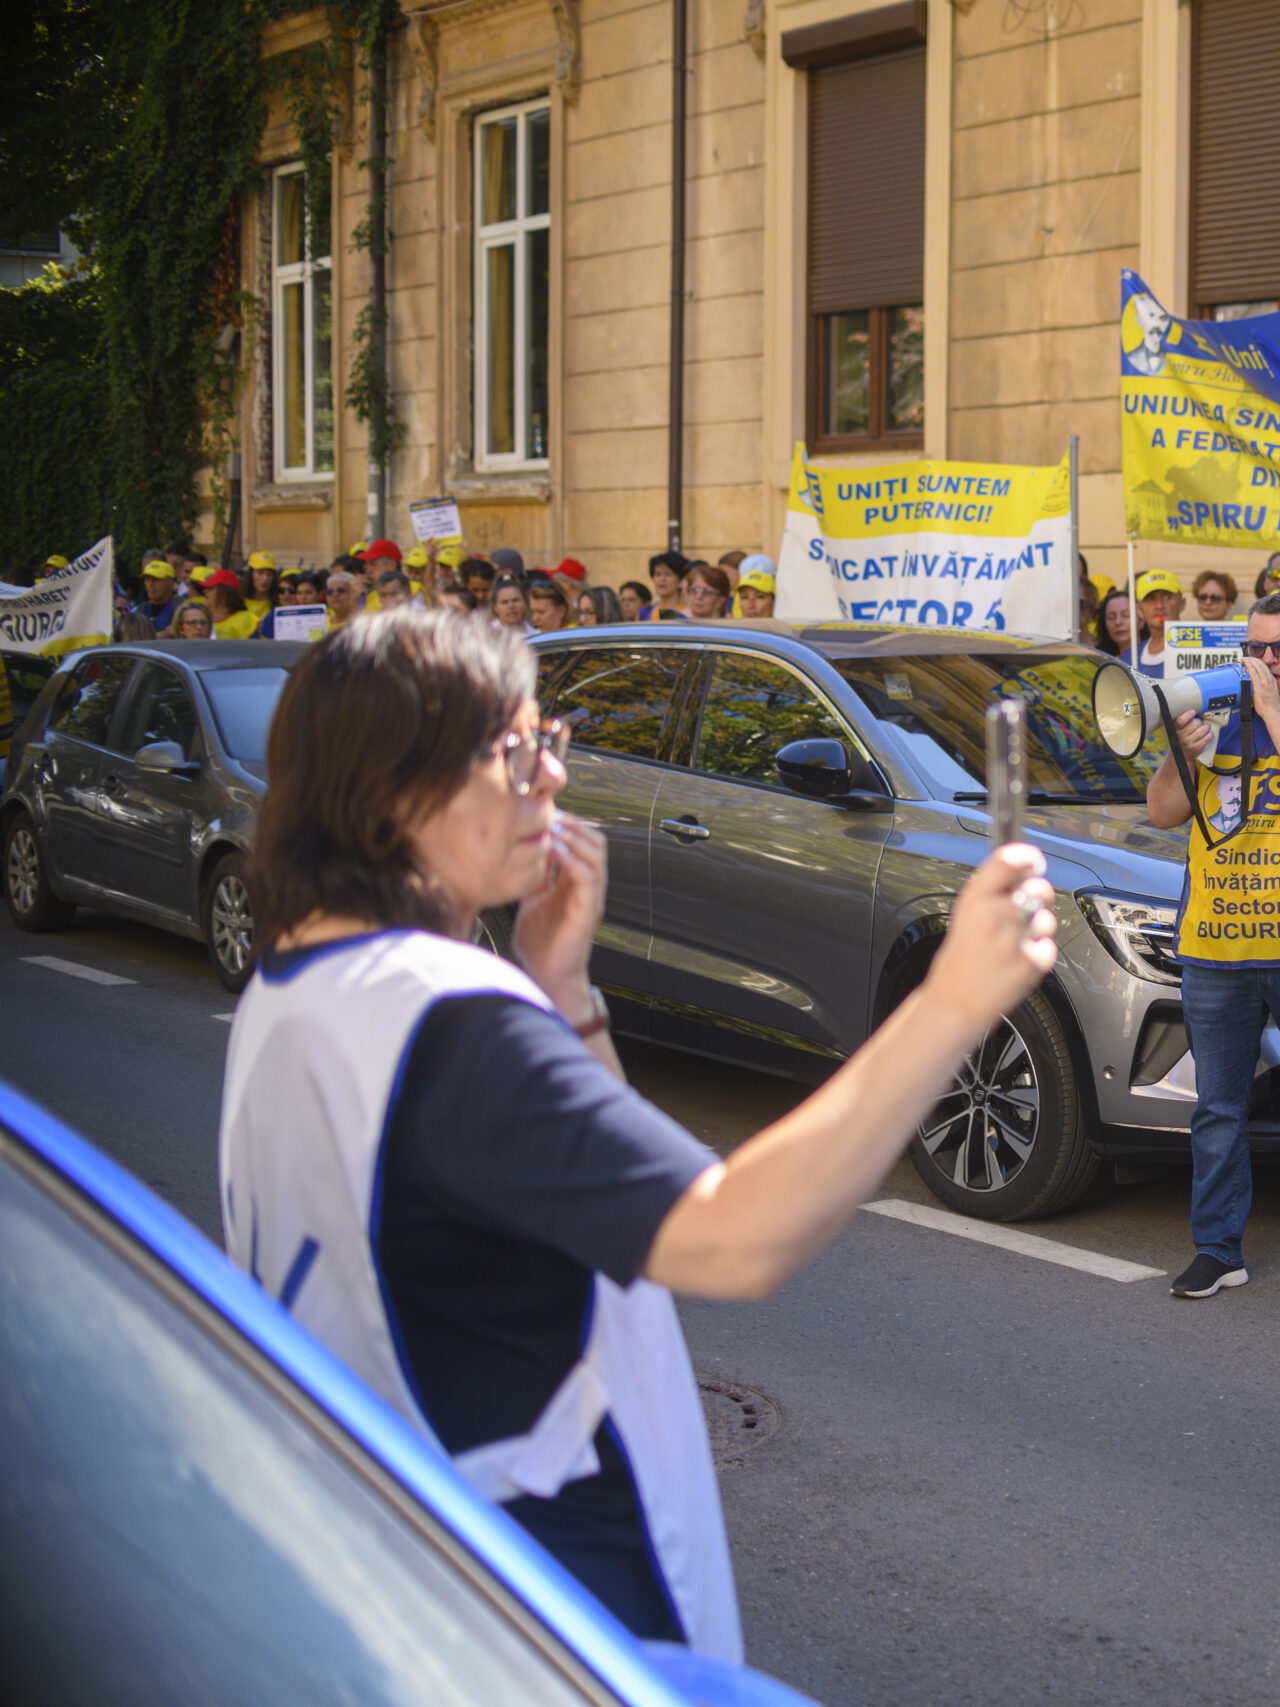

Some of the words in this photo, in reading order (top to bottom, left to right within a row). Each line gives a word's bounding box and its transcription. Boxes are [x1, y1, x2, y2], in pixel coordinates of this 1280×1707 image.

[1151, 428, 1166, 448] A
[837, 477, 908, 502] UNIȚI
[917, 475, 1011, 497] SUNTEM
[864, 502, 994, 525] PUTERNICI!
[1179, 627, 1203, 640] FSE
[1176, 653, 1202, 670] CUM
[1246, 816, 1276, 831] piru
